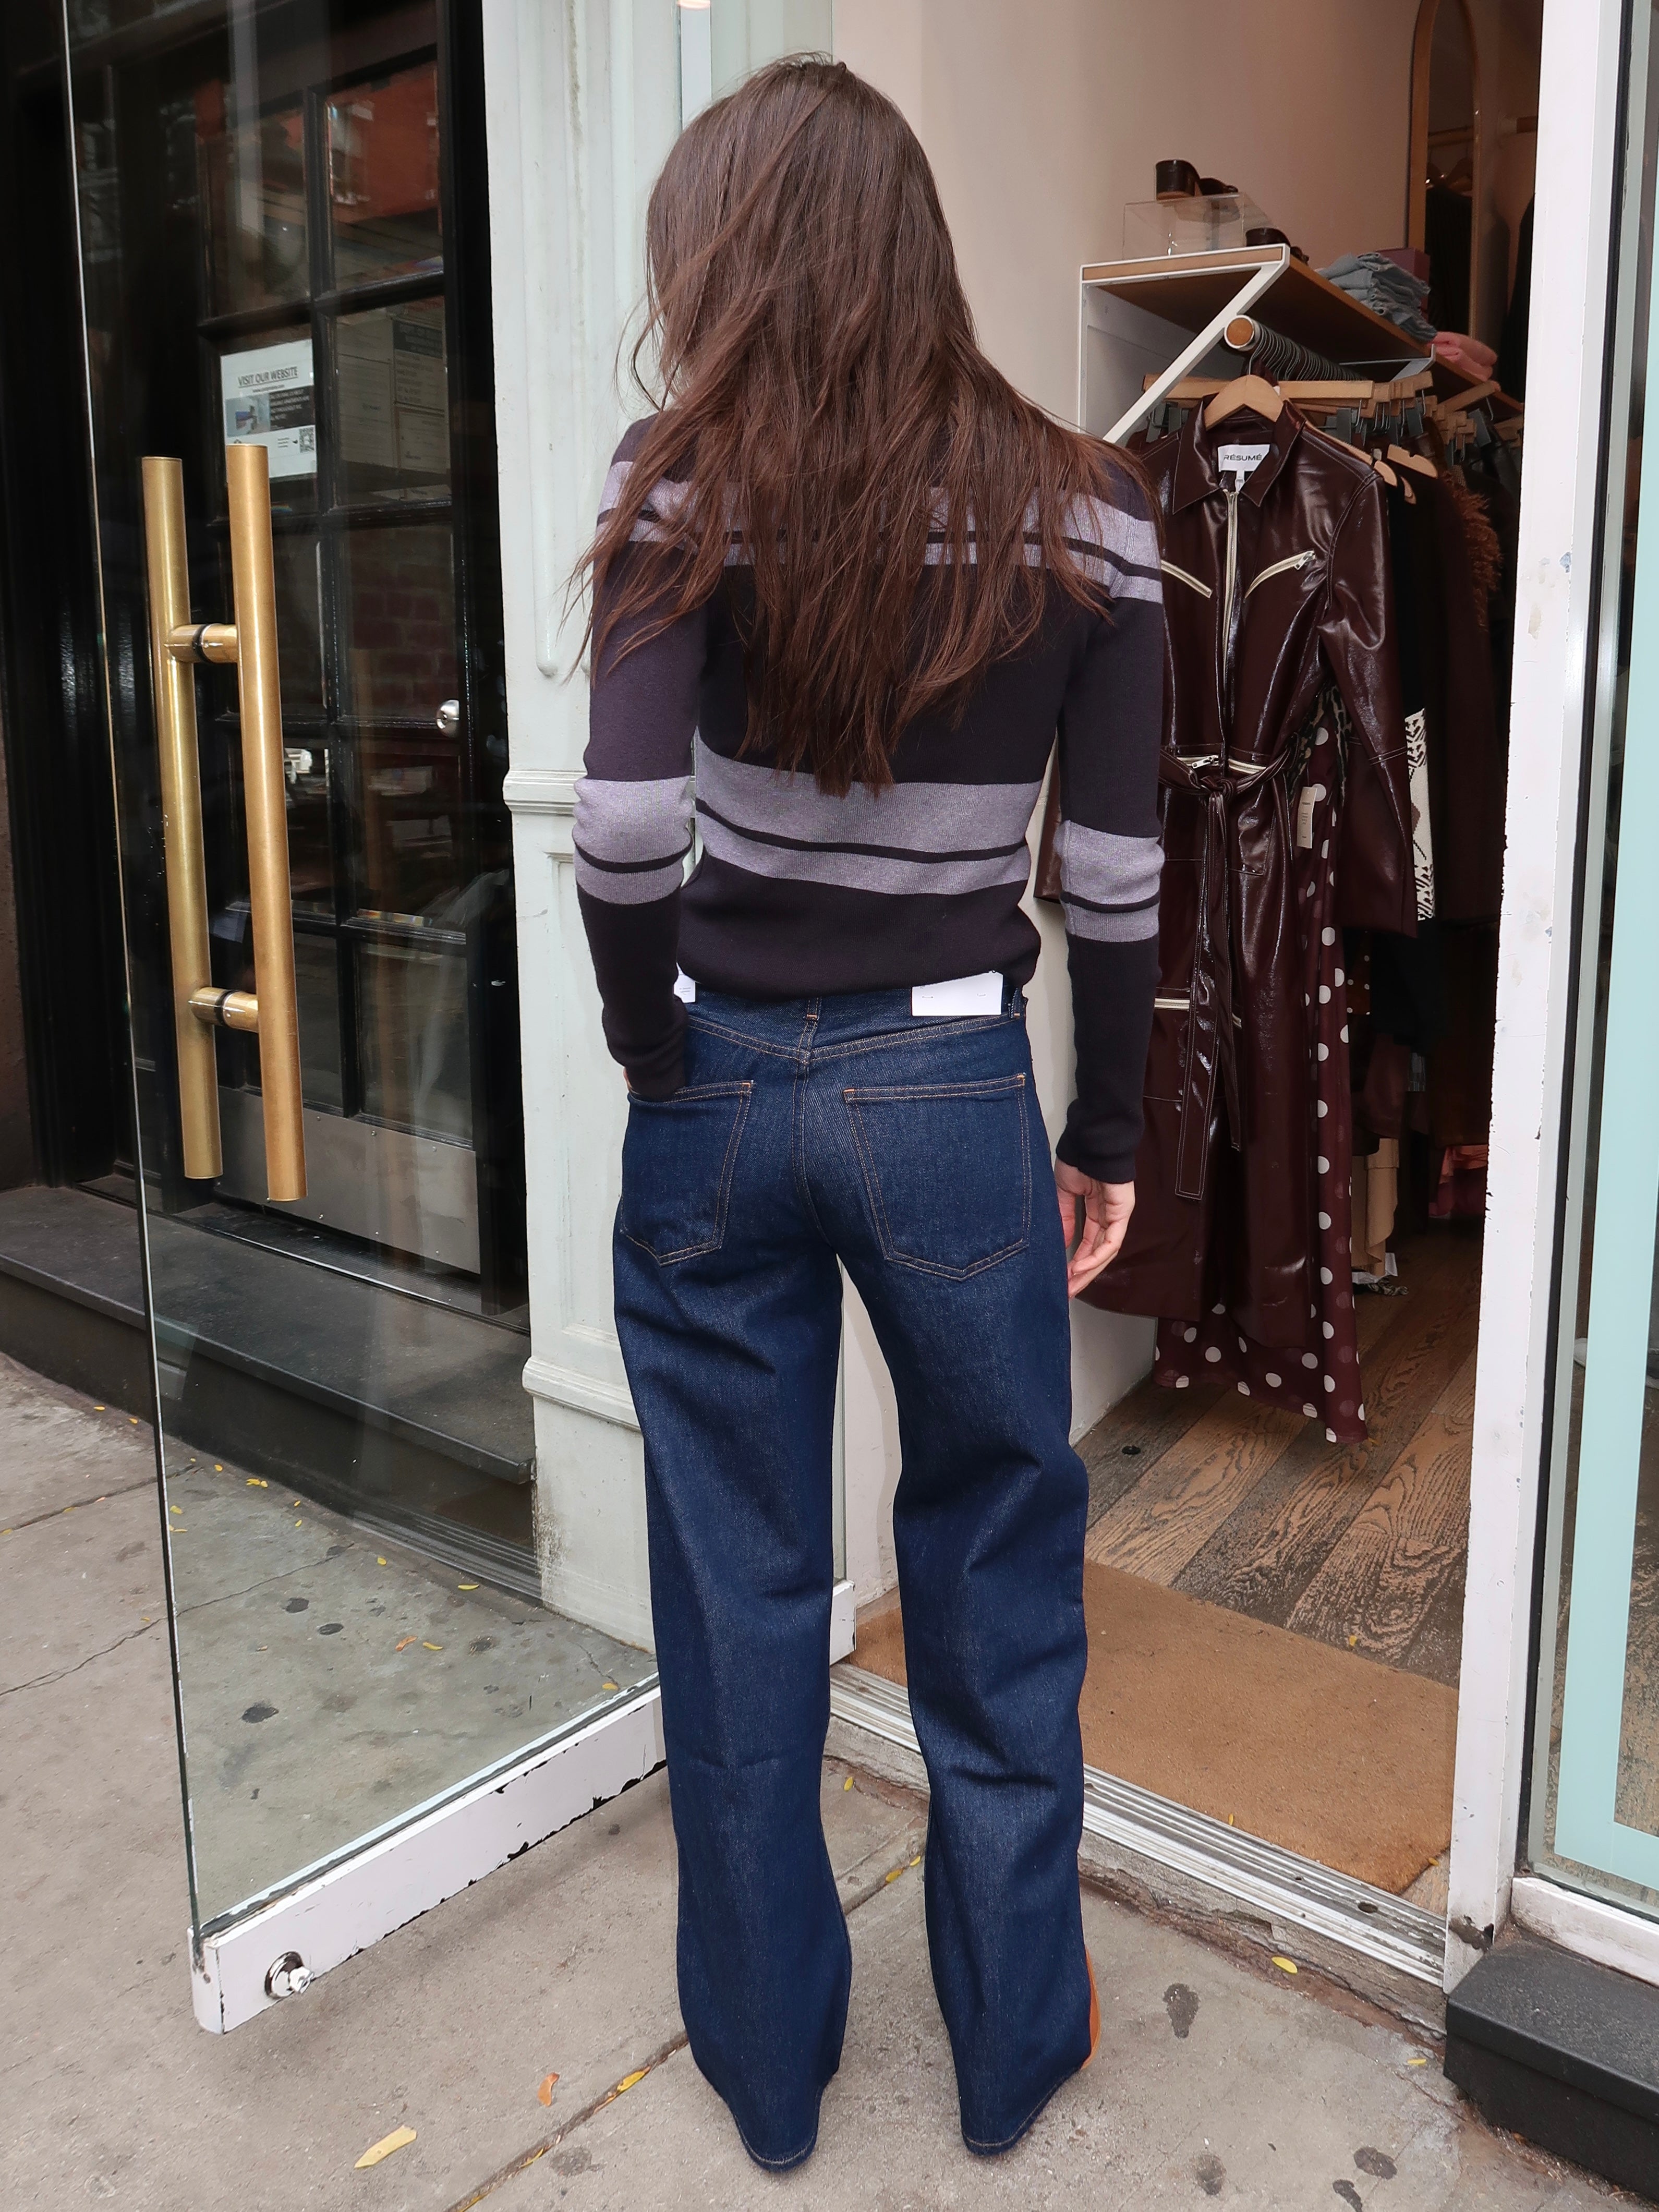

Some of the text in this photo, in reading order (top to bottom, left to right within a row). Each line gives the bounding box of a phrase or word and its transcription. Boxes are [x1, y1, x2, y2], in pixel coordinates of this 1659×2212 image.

[238, 366, 298, 385] VISIT OUR WEBSITE
